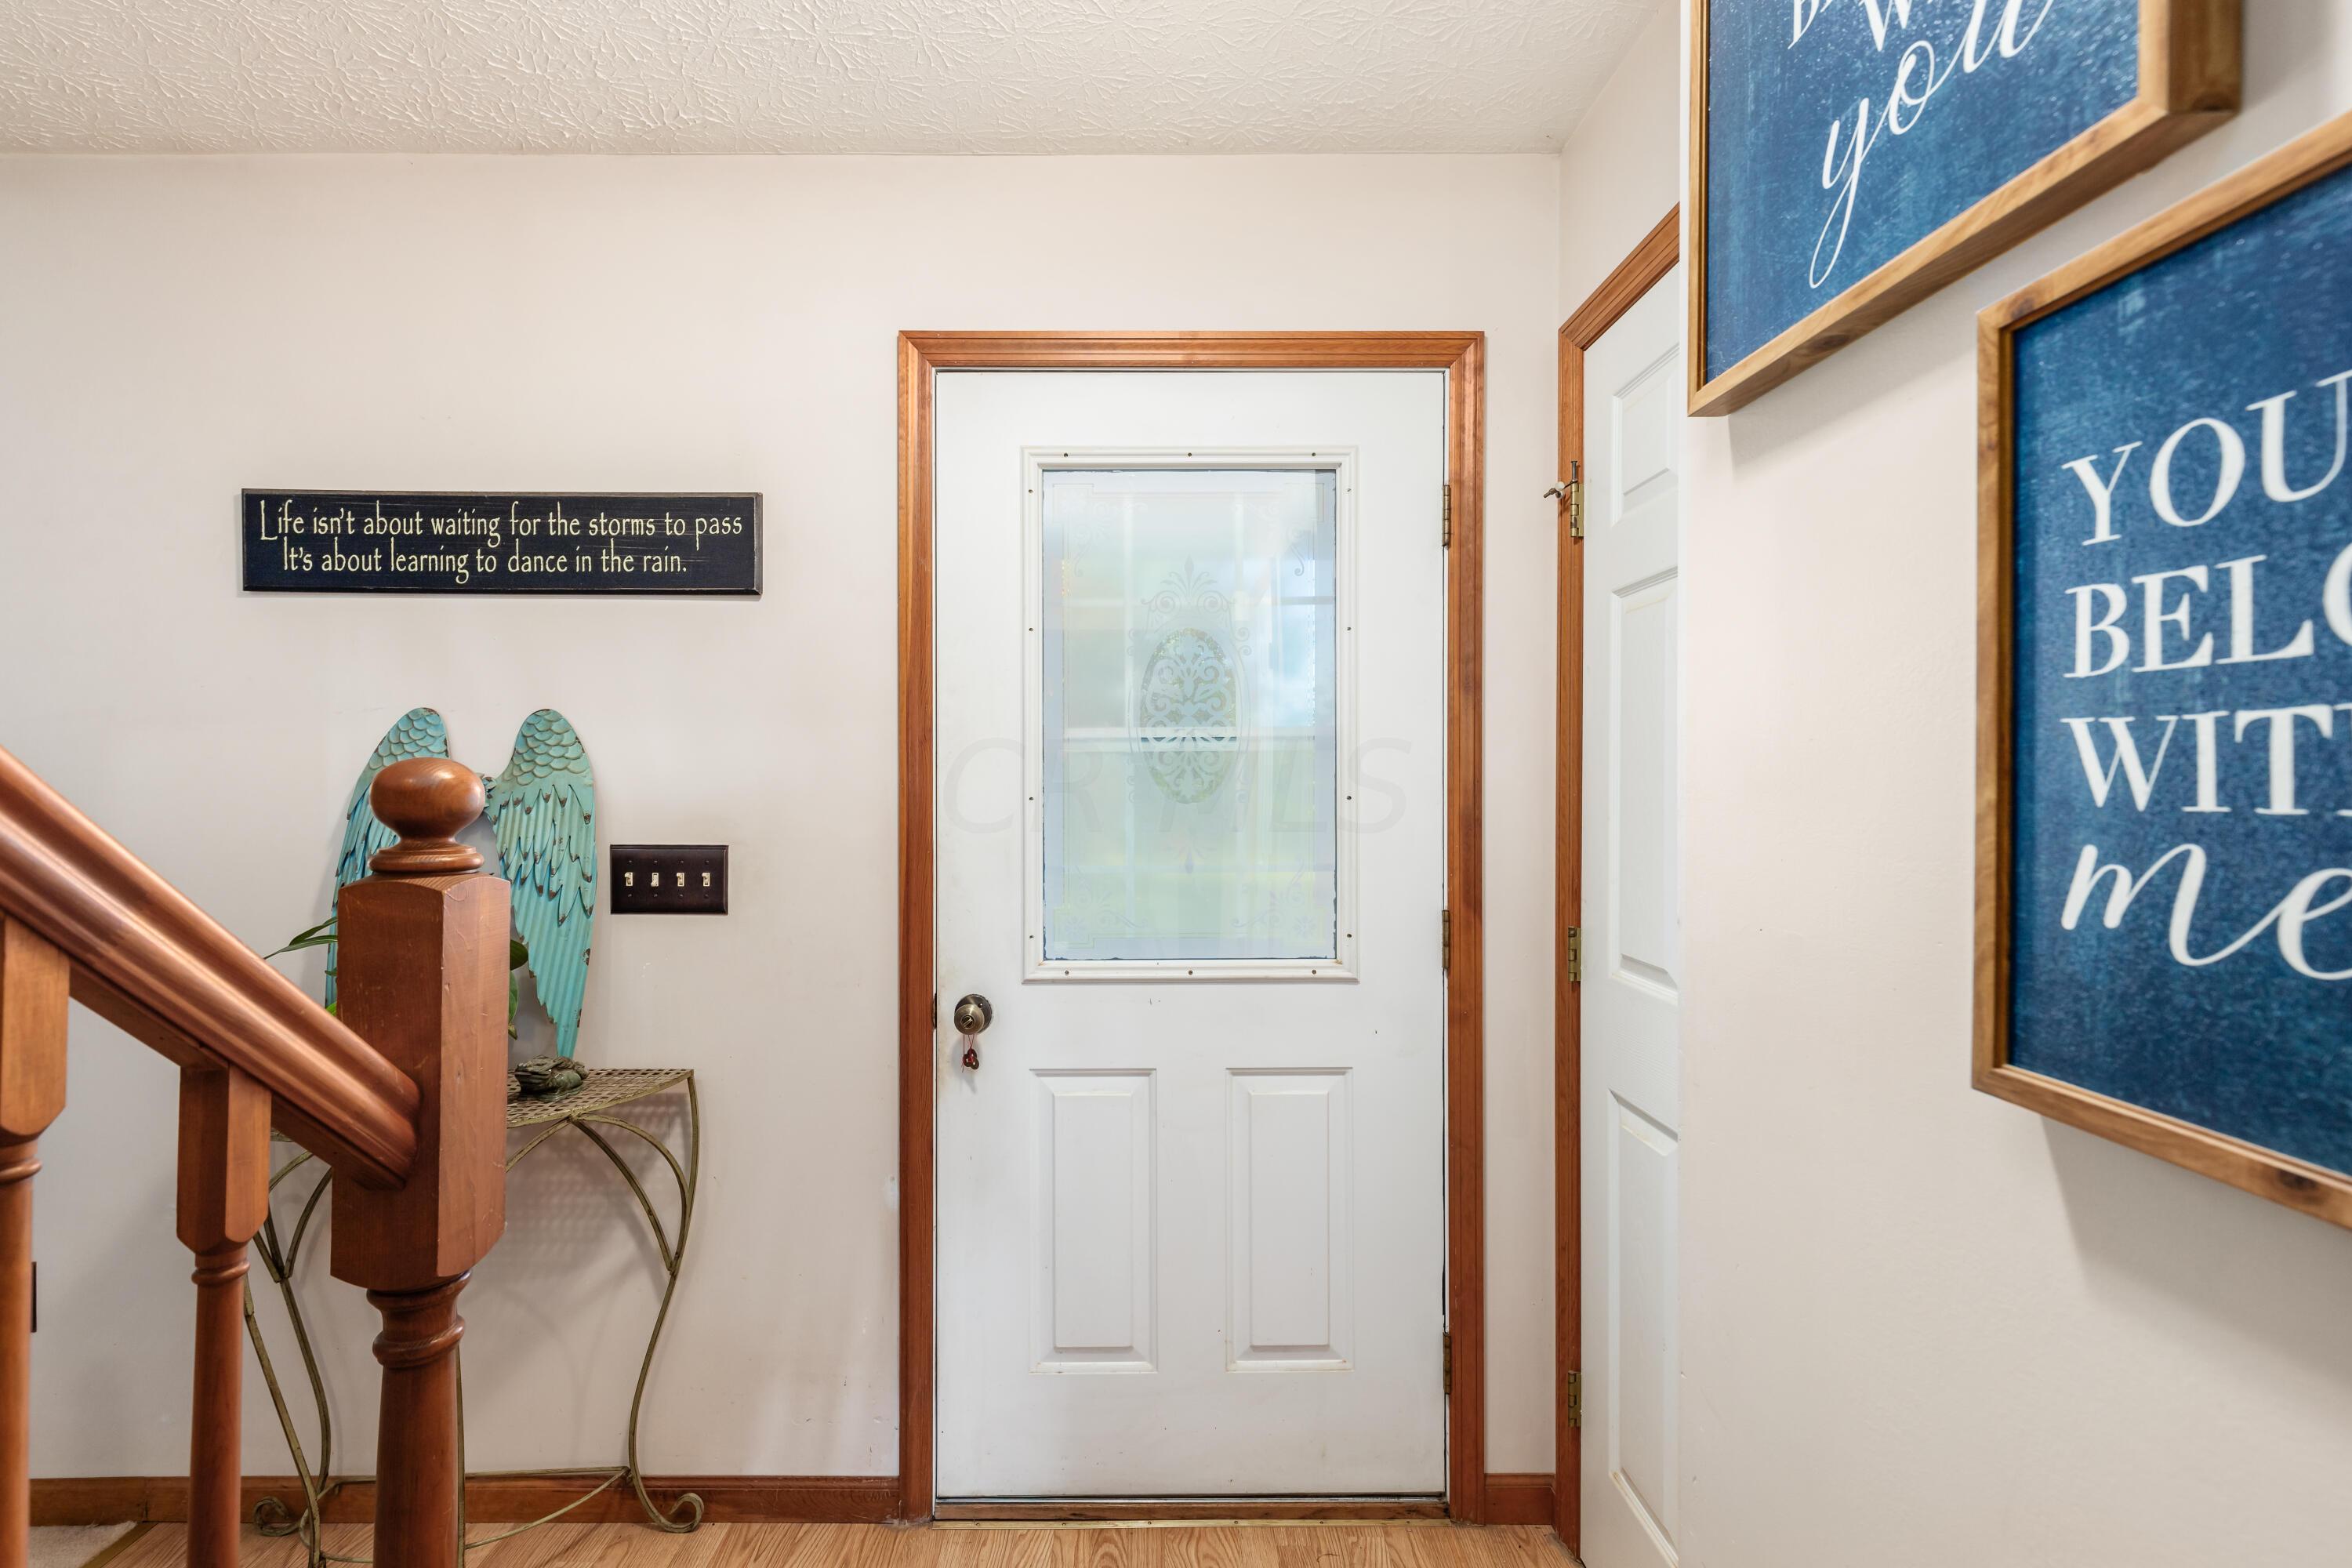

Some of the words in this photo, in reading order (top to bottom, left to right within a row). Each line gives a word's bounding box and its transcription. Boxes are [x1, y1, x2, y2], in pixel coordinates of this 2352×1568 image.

[2061, 369, 2352, 546] YOU
[260, 499, 305, 541] Life
[313, 507, 355, 535] isn't
[363, 499, 423, 535] about
[430, 508, 501, 549] waiting
[510, 500, 542, 536] for
[547, 501, 581, 536] the
[588, 512, 660, 536] storms
[664, 512, 686, 536] to
[695, 517, 742, 551] pass
[283, 535, 313, 572] It's
[321, 536, 383, 572] about
[390, 536, 470, 584] learning
[475, 548, 497, 572] to
[507, 538, 568, 573] dance
[575, 545, 592, 572] in
[601, 537, 634, 573] the
[643, 545, 687, 573] rain.
[2063, 543, 2352, 679] BEL
[2060, 702, 2352, 815] WIT
[2061, 843, 2352, 981] me
